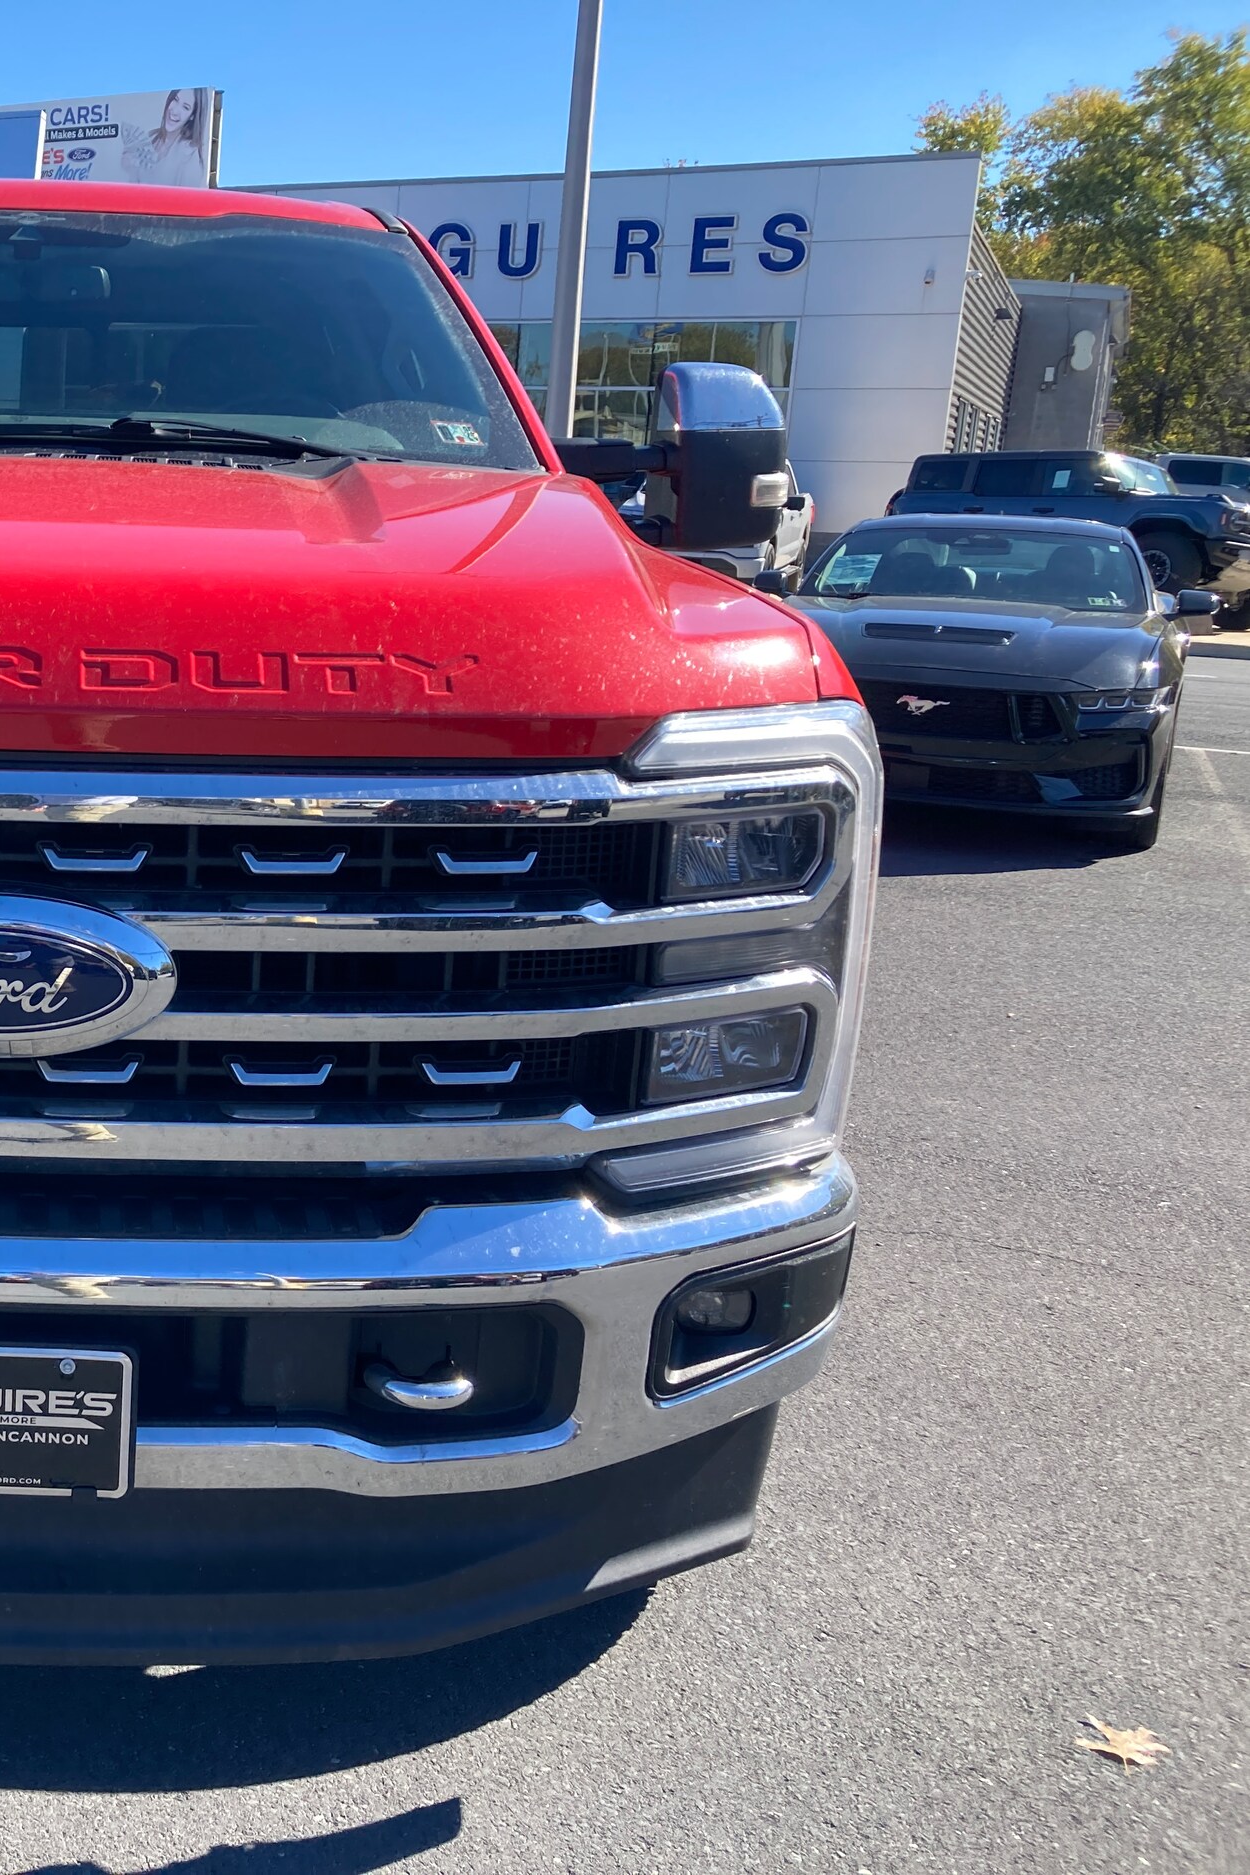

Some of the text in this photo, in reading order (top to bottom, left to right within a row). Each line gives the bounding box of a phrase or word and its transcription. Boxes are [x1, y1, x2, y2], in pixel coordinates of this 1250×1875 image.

[50, 104, 109, 126] CARS!
[50, 130, 76, 140] Makes
[77, 128, 84, 138] &
[85, 126, 116, 137] Models
[54, 163, 93, 180] More!
[80, 648, 480, 695] DUTY
[0, 1415, 37, 1425] MORE
